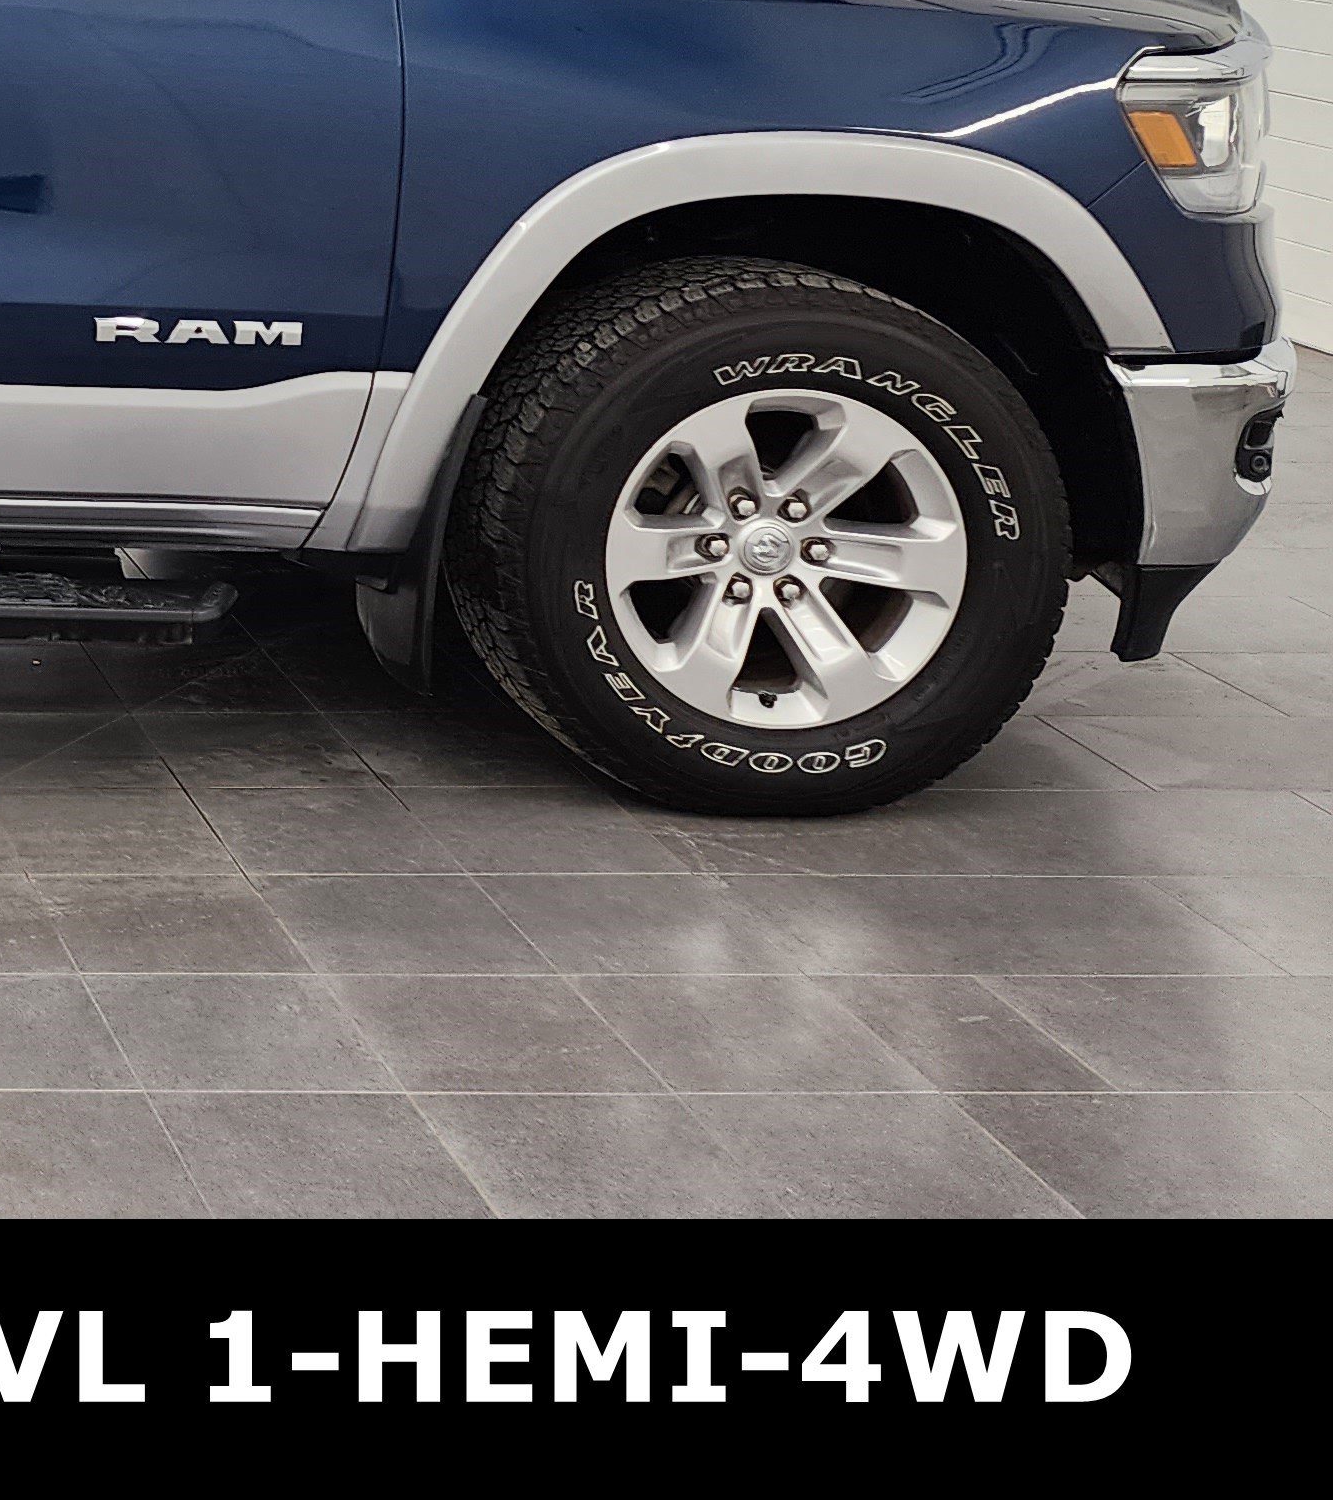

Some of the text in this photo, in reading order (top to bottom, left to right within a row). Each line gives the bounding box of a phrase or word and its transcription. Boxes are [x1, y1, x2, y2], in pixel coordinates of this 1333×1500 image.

[93, 315, 305, 346] RAM
[711, 352, 1021, 541] WRANGLER
[572, 579, 888, 775] GOODYEAR
